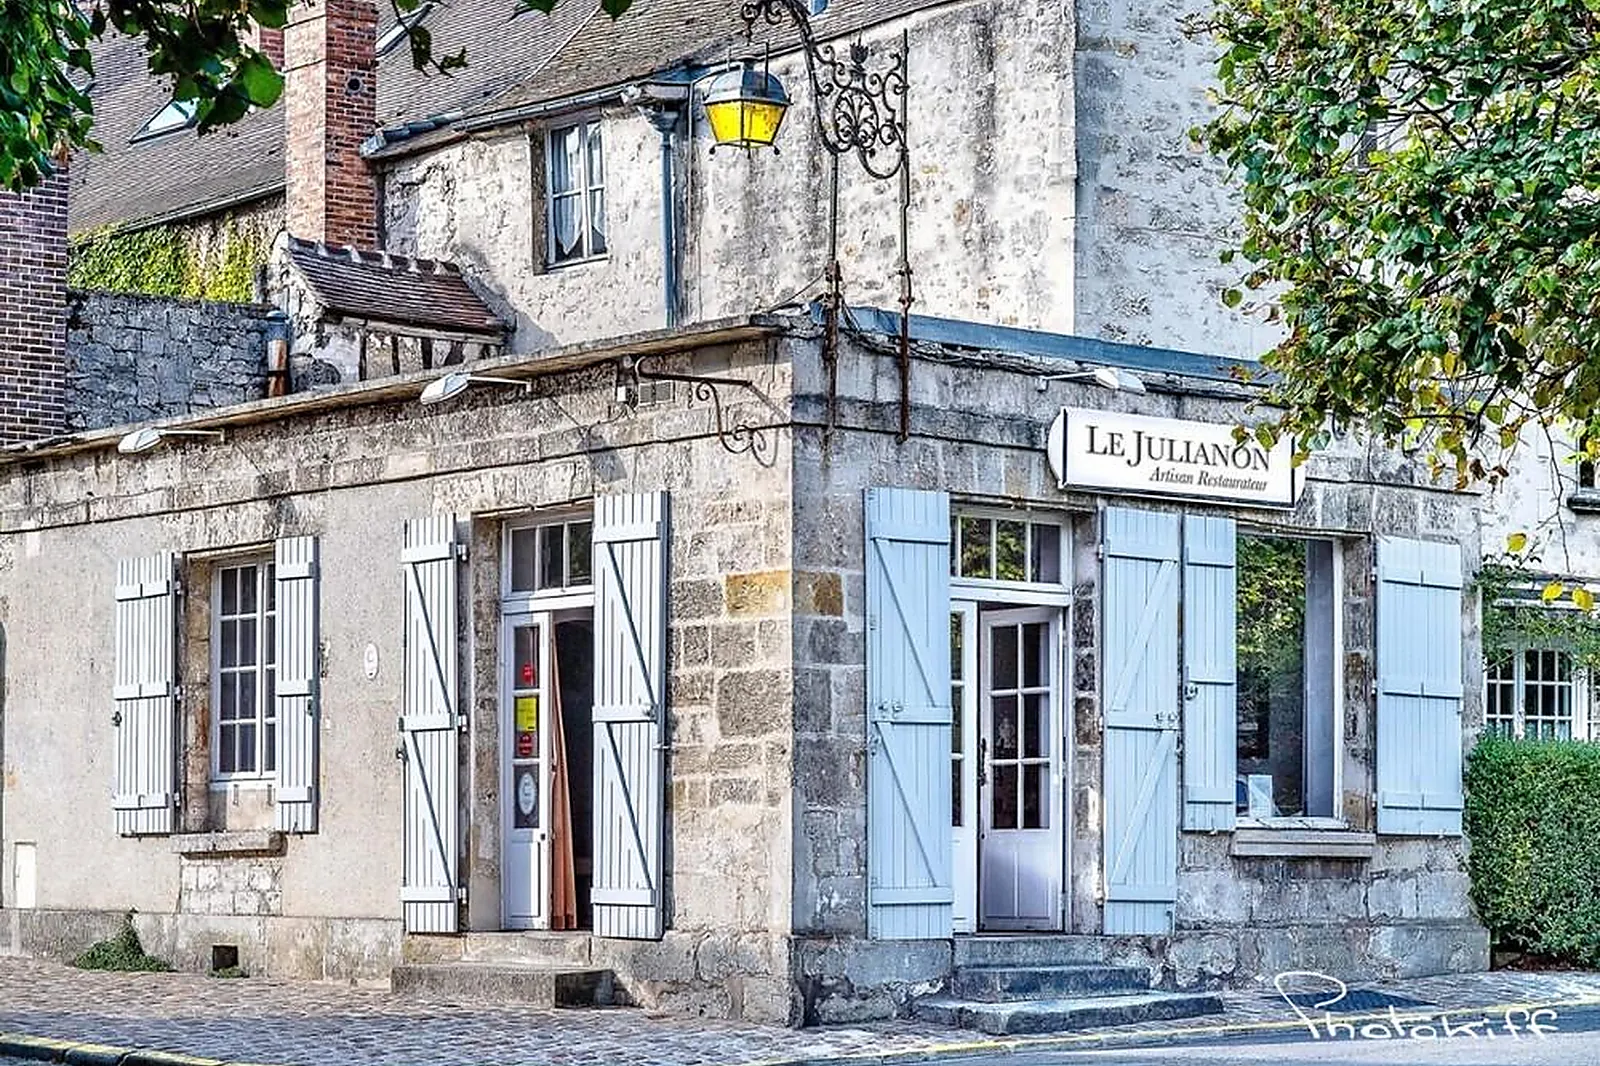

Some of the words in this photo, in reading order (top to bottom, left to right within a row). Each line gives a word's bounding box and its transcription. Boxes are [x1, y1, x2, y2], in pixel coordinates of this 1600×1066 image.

[1085, 425, 1125, 457] LE
[1127, 430, 1270, 471] JULIANON
[1149, 467, 1193, 485] Artisan
[1197, 470, 1268, 491] Restaurateur
